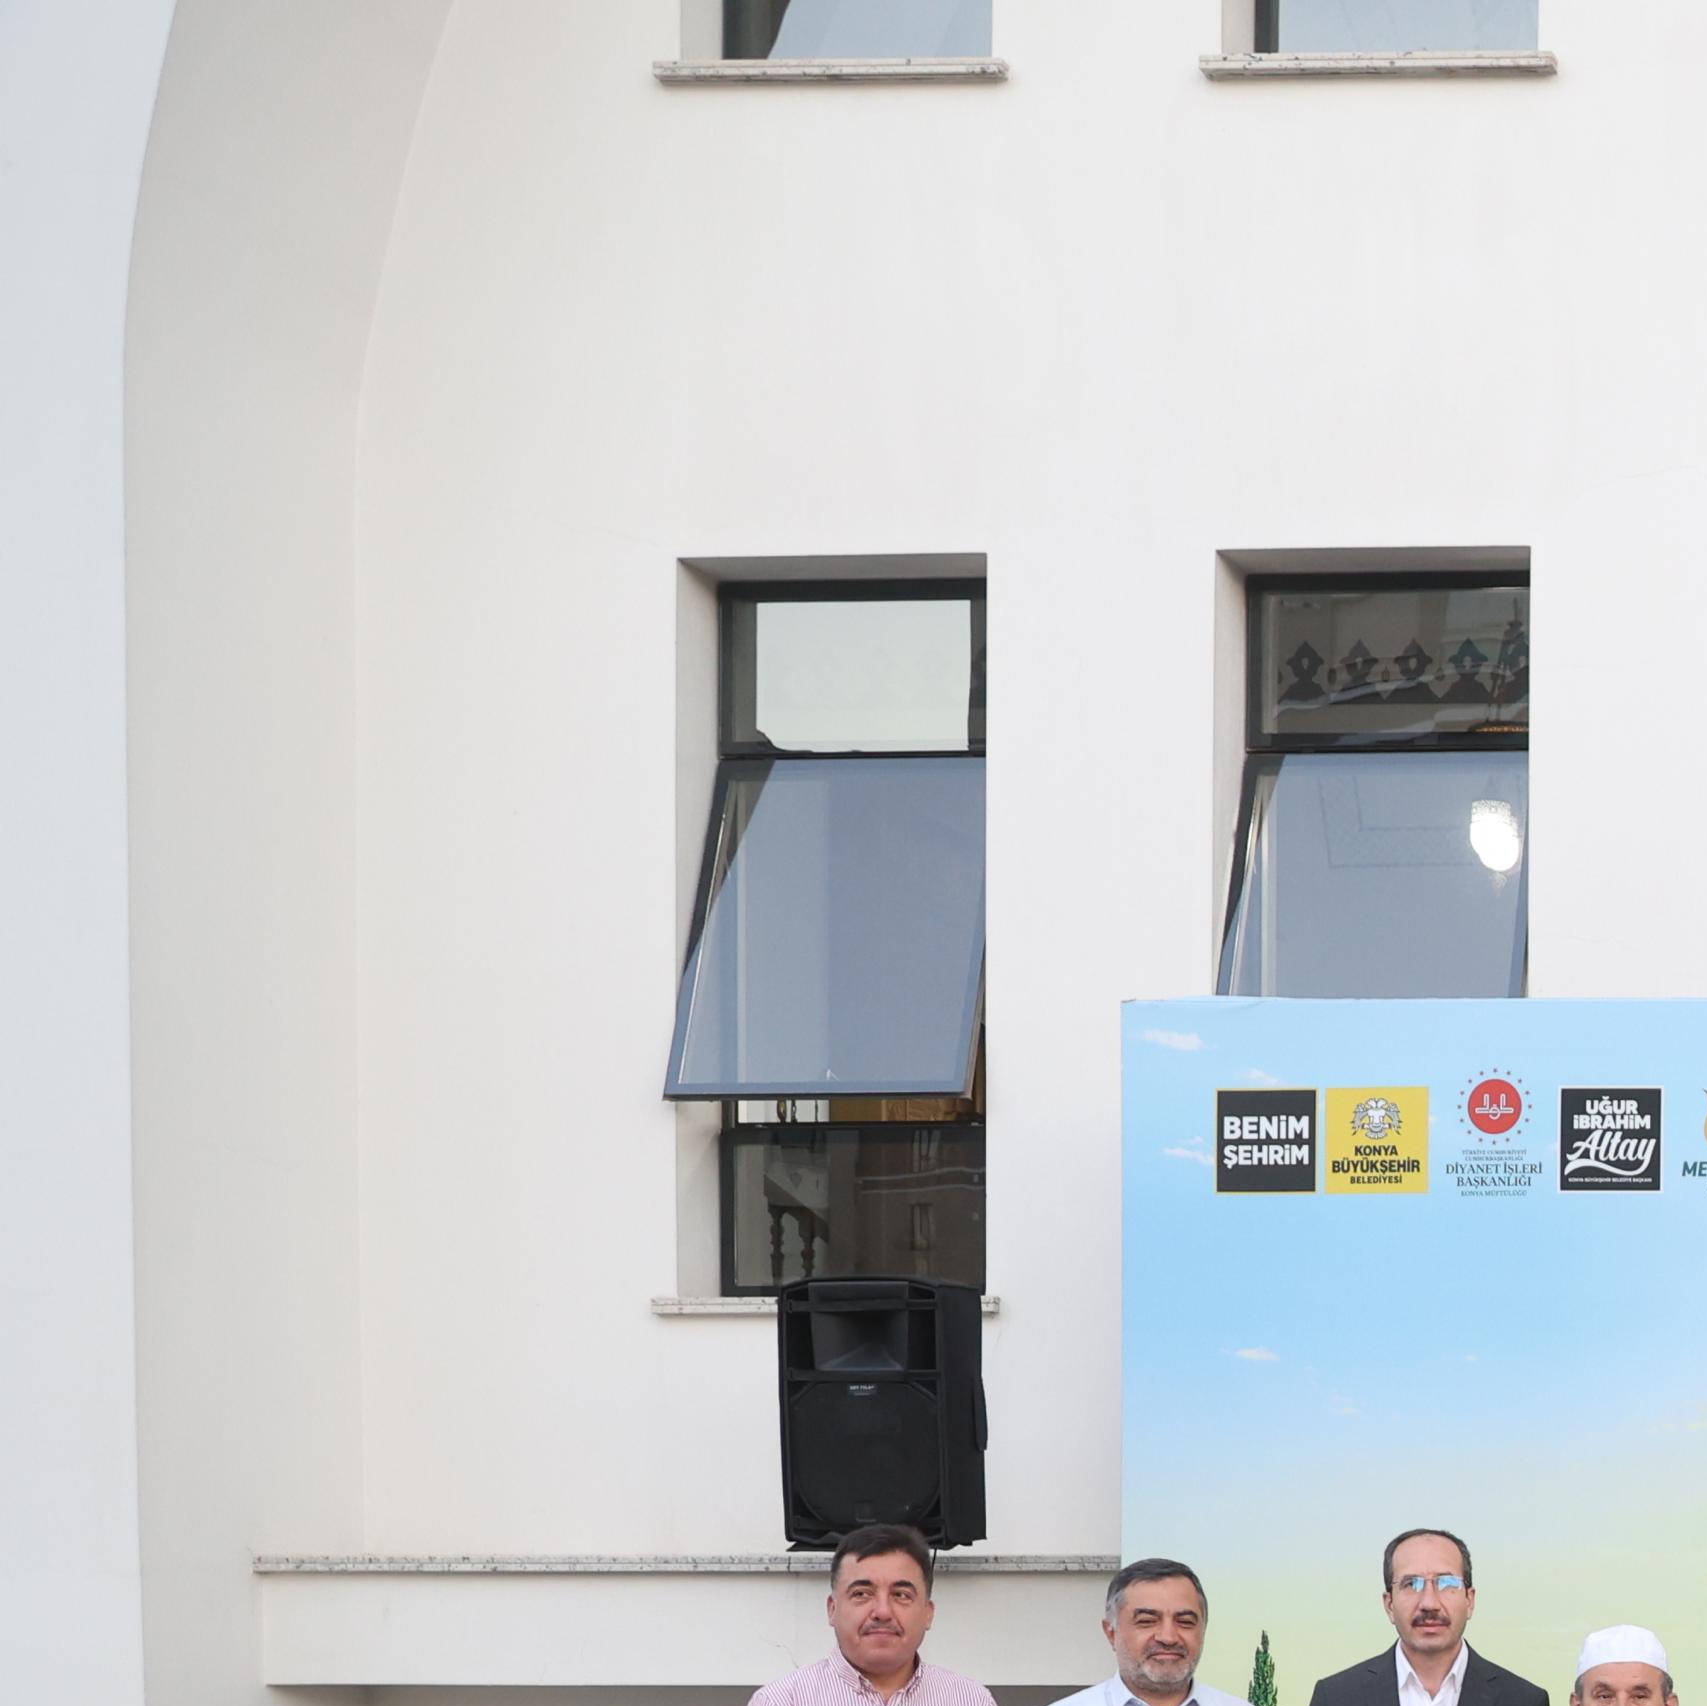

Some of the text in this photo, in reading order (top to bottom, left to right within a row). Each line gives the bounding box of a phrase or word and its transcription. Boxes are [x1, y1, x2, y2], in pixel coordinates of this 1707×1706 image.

[1586, 1096, 1637, 1114] UĞUR
[1354, 1145, 1398, 1157] KONYA
[1564, 1129, 1656, 1176] Altay
[1331, 1157, 1420, 1175] BÜYÜKŞEHİR
[1446, 1161, 1542, 1176] DİYANET İŞLERİ
[1349, 1175, 1402, 1184] BELEDİYESİ
[1457, 1174, 1531, 1189] BAŞKANLIĞI
